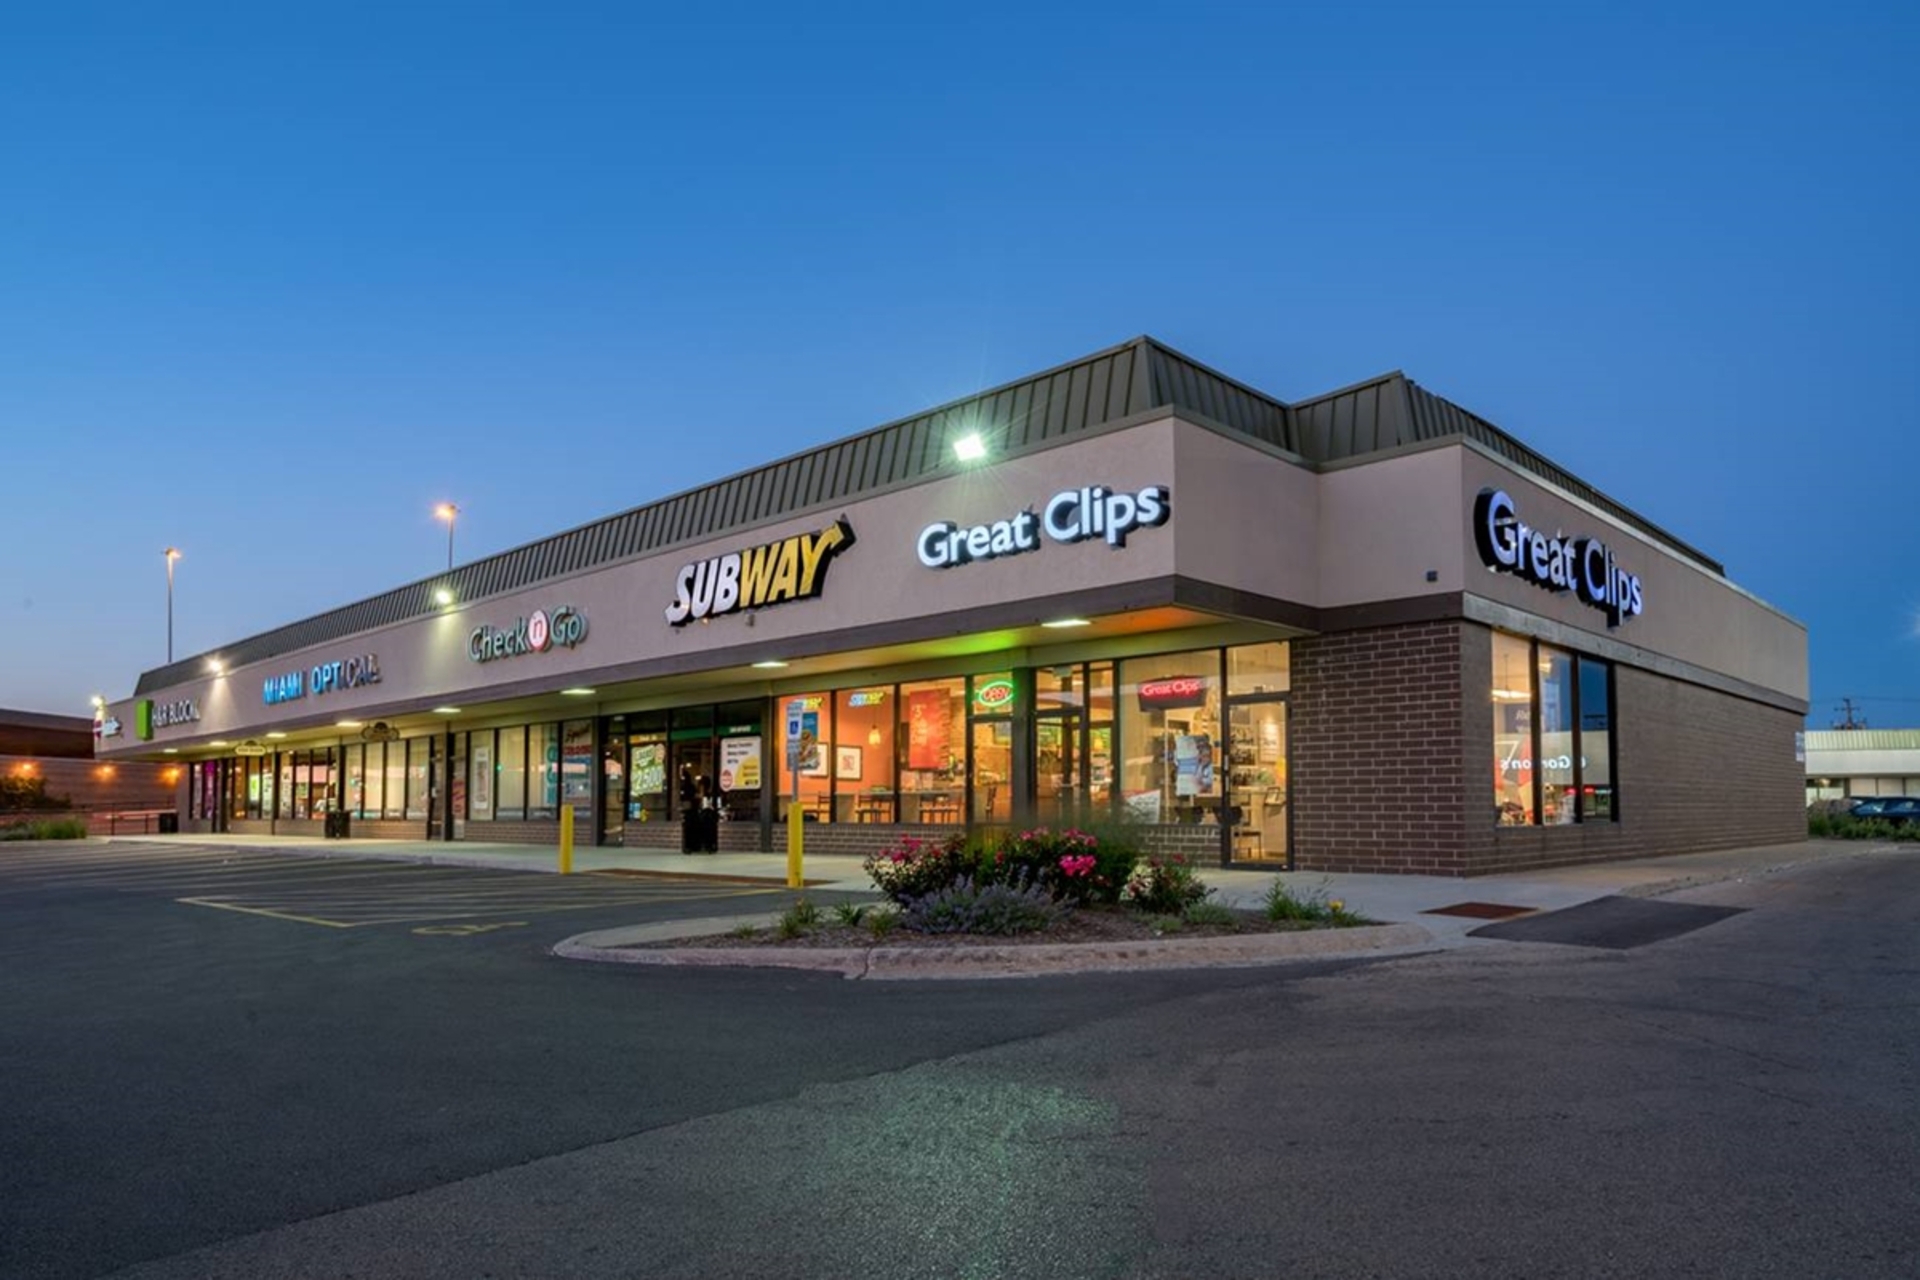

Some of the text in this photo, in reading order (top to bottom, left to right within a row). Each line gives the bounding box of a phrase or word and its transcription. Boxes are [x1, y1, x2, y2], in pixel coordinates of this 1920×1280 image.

[918, 486, 1168, 568] Great Clips
[1481, 489, 1643, 625] Great Clips
[664, 516, 855, 626] SUBWAY
[469, 615, 528, 661] Check
[550, 605, 588, 646] Go
[263, 654, 381, 705] MIAMI OPTICAL
